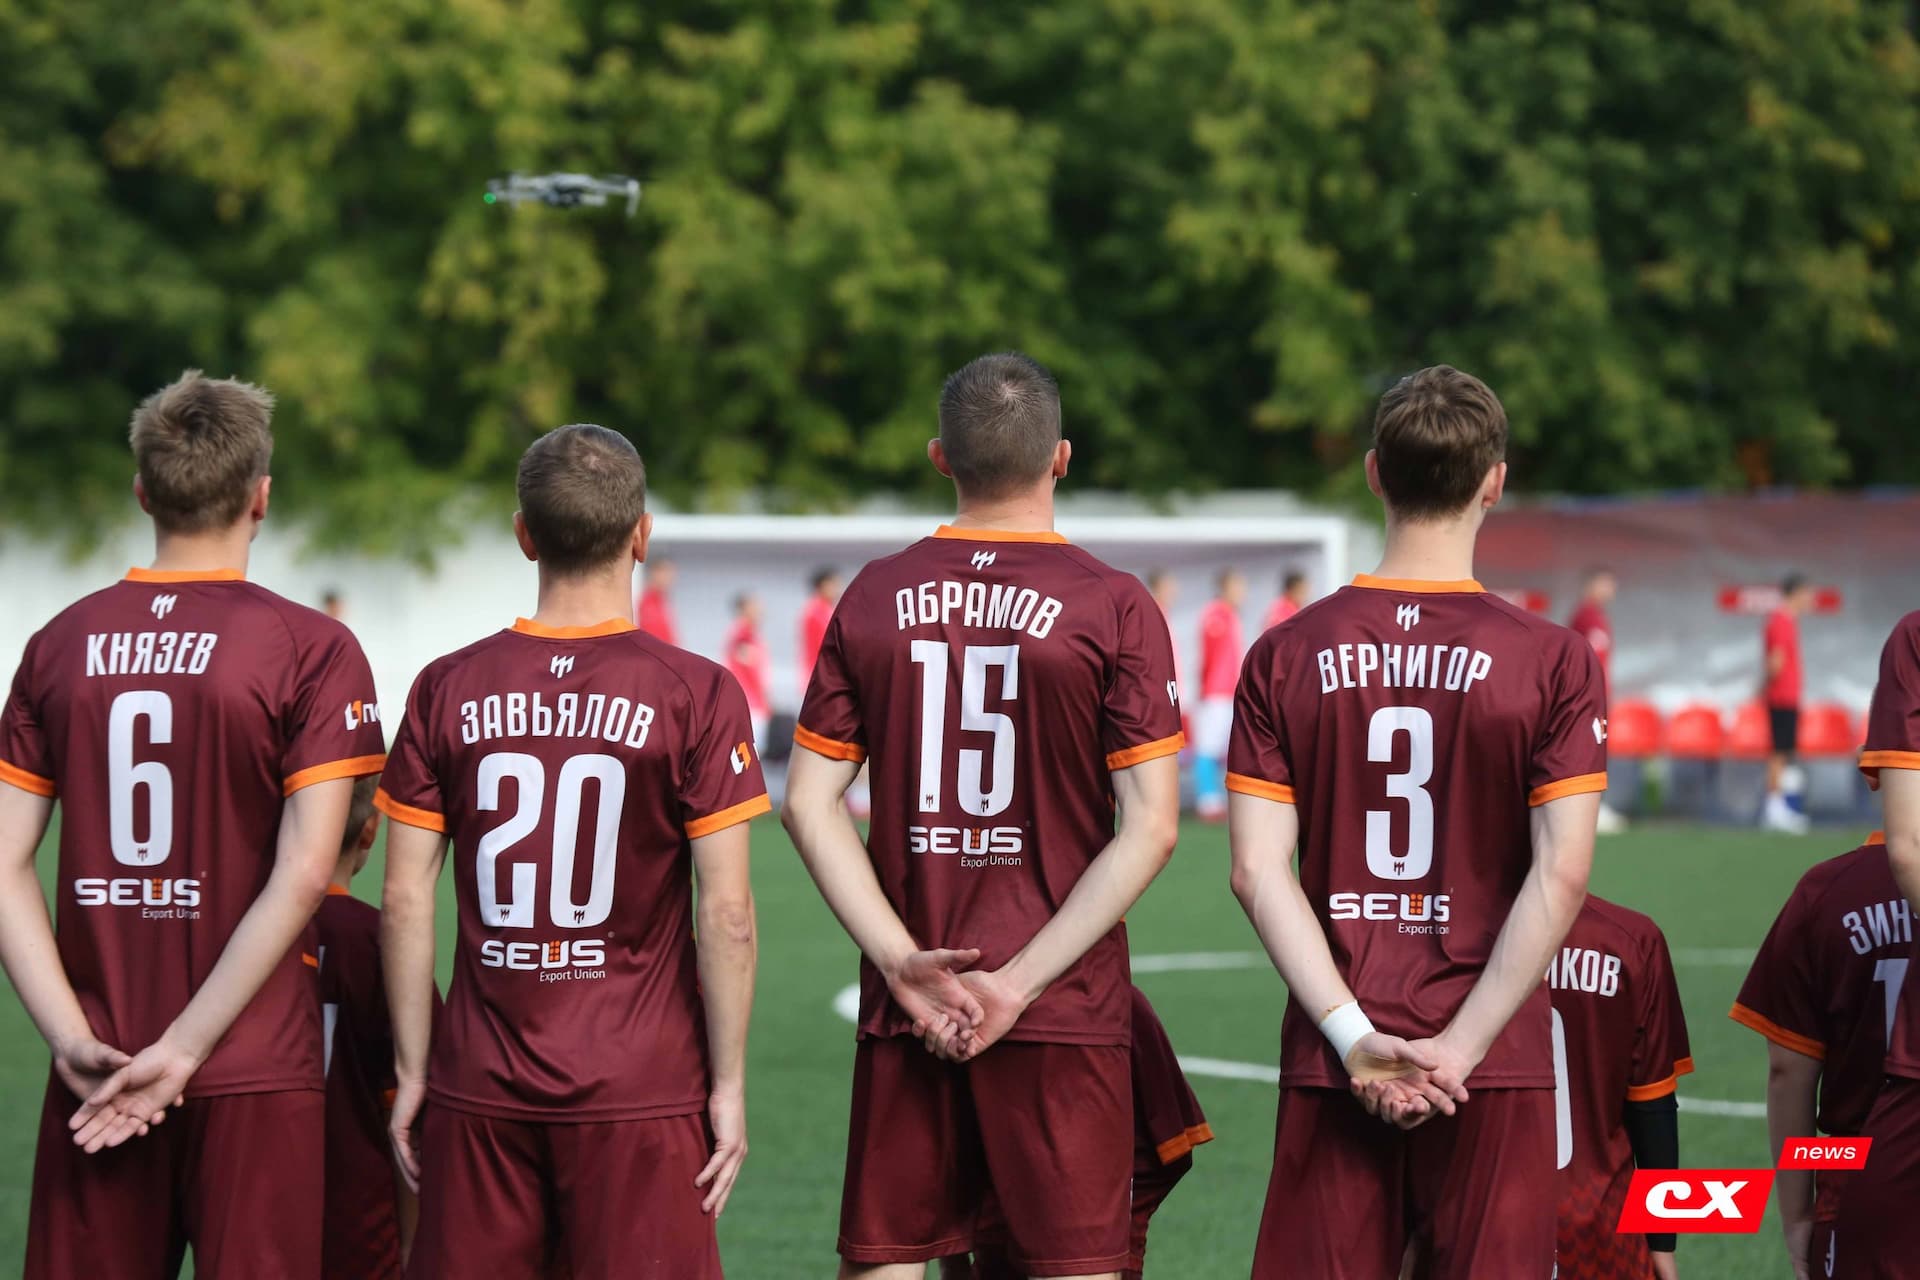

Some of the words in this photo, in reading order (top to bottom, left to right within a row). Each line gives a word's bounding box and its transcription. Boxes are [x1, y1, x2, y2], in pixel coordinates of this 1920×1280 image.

[895, 580, 1063, 639] АБРАМОВ
[86, 631, 218, 677] КНЯЗЕВ
[1317, 642, 1493, 695] ВЕРНИГОР
[460, 691, 655, 749] ЗАВЬЯЛОВ
[910, 639, 1020, 817] 15
[108, 690, 173, 867] 6
[1365, 706, 1434, 881] 3
[476, 751, 626, 929] 20
[909, 826, 1023, 855] SEUS
[960, 856, 988, 869] Export
[989, 854, 1022, 866] Union
[74, 878, 201, 907] SEUS
[1329, 892, 1450, 922] SEUS
[1398, 922, 1433, 935] Export
[1842, 898, 1920, 955] ЗИН
[480, 939, 606, 970] SEUS
[539, 970, 572, 983] Export
[574, 968, 606, 980] Union
